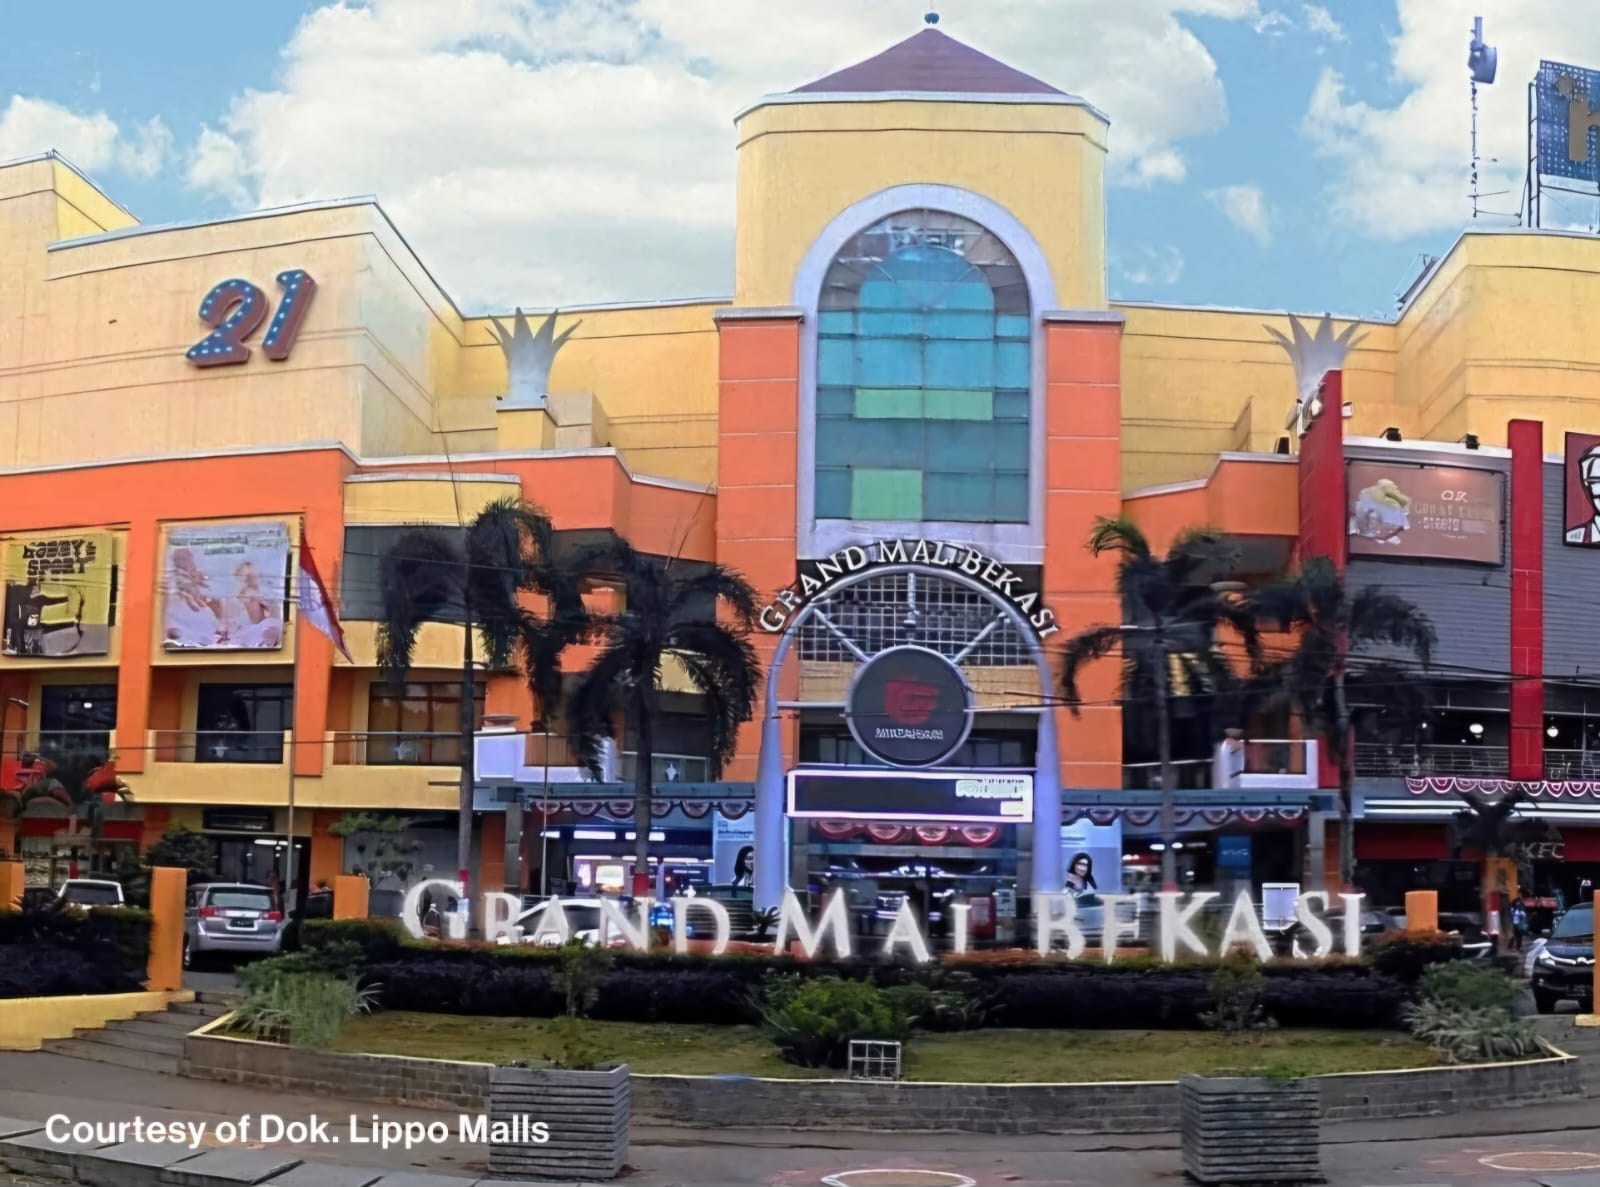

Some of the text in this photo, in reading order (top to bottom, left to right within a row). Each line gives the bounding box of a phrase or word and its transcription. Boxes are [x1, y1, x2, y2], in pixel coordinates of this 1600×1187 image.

[185, 269, 318, 368] 21
[759, 545, 867, 633] GRAND
[959, 548, 1059, 639] BEKASI
[1521, 841, 1566, 859] KFC
[401, 878, 731, 956] GRAND
[1031, 888, 1367, 964] BEKASI
